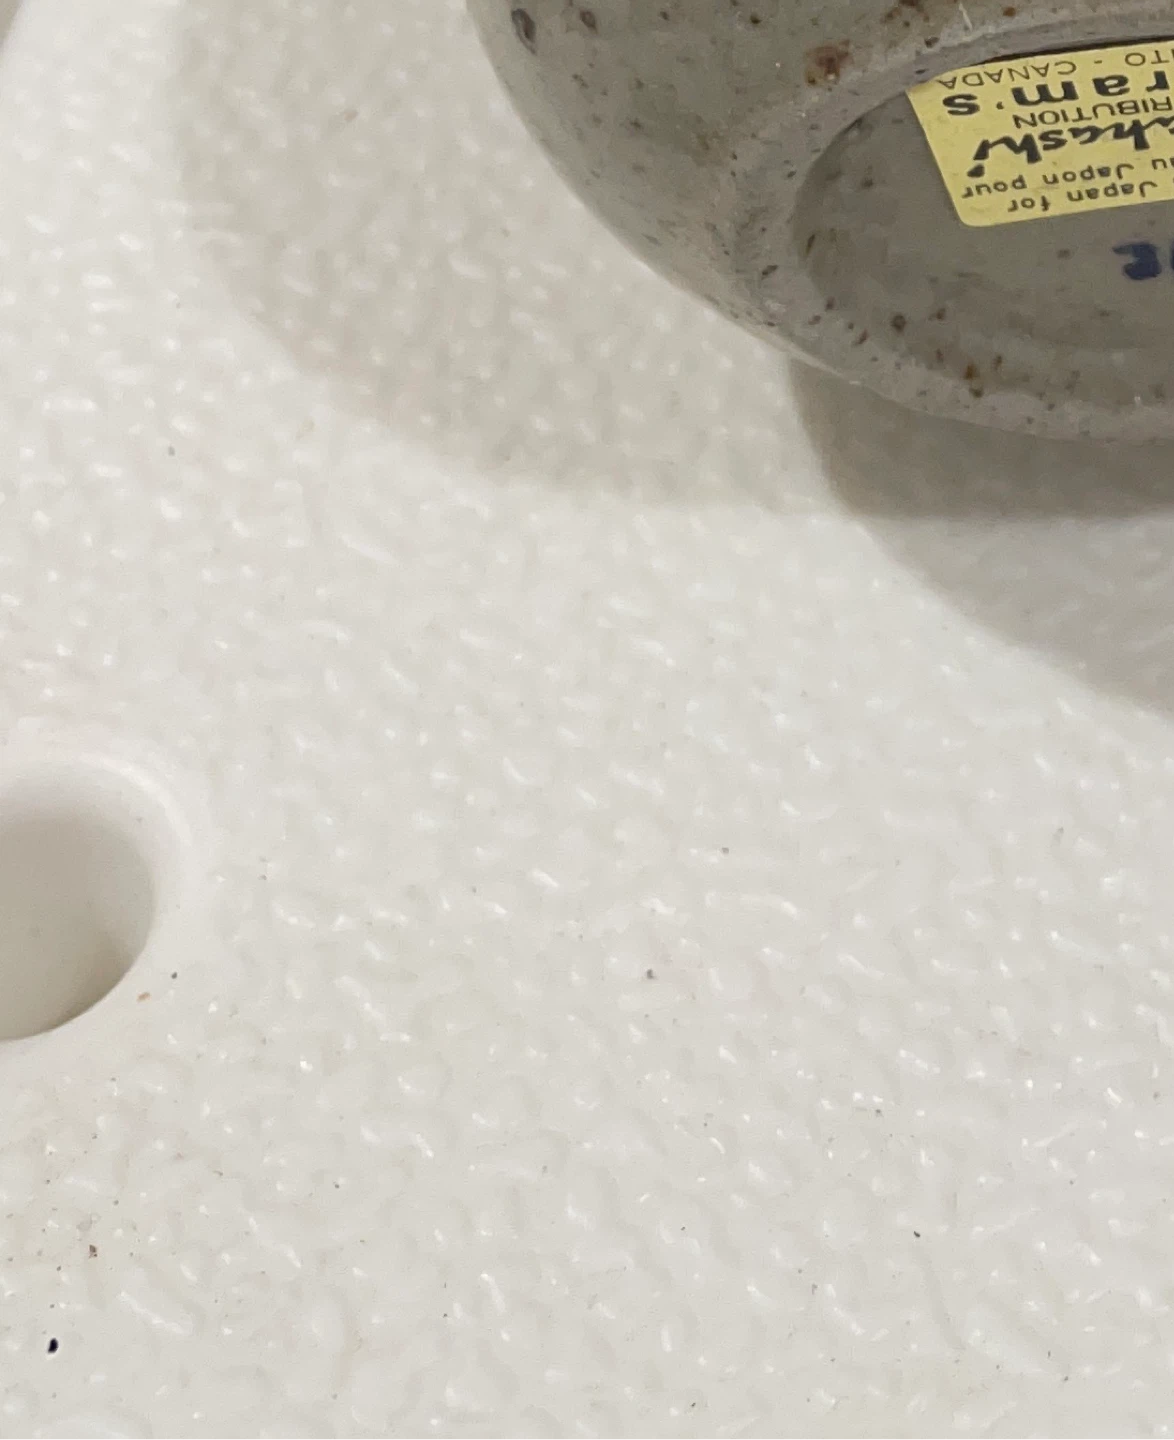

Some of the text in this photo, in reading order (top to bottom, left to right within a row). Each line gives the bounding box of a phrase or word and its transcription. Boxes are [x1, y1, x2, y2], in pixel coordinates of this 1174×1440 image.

[936, 60, 1076, 91] CANADA
[1042, 162, 1134, 186] Japon
[960, 174, 1025, 199] pour
[1066, 180, 1157, 204] Japan
[1006, 195, 1049, 214] for
